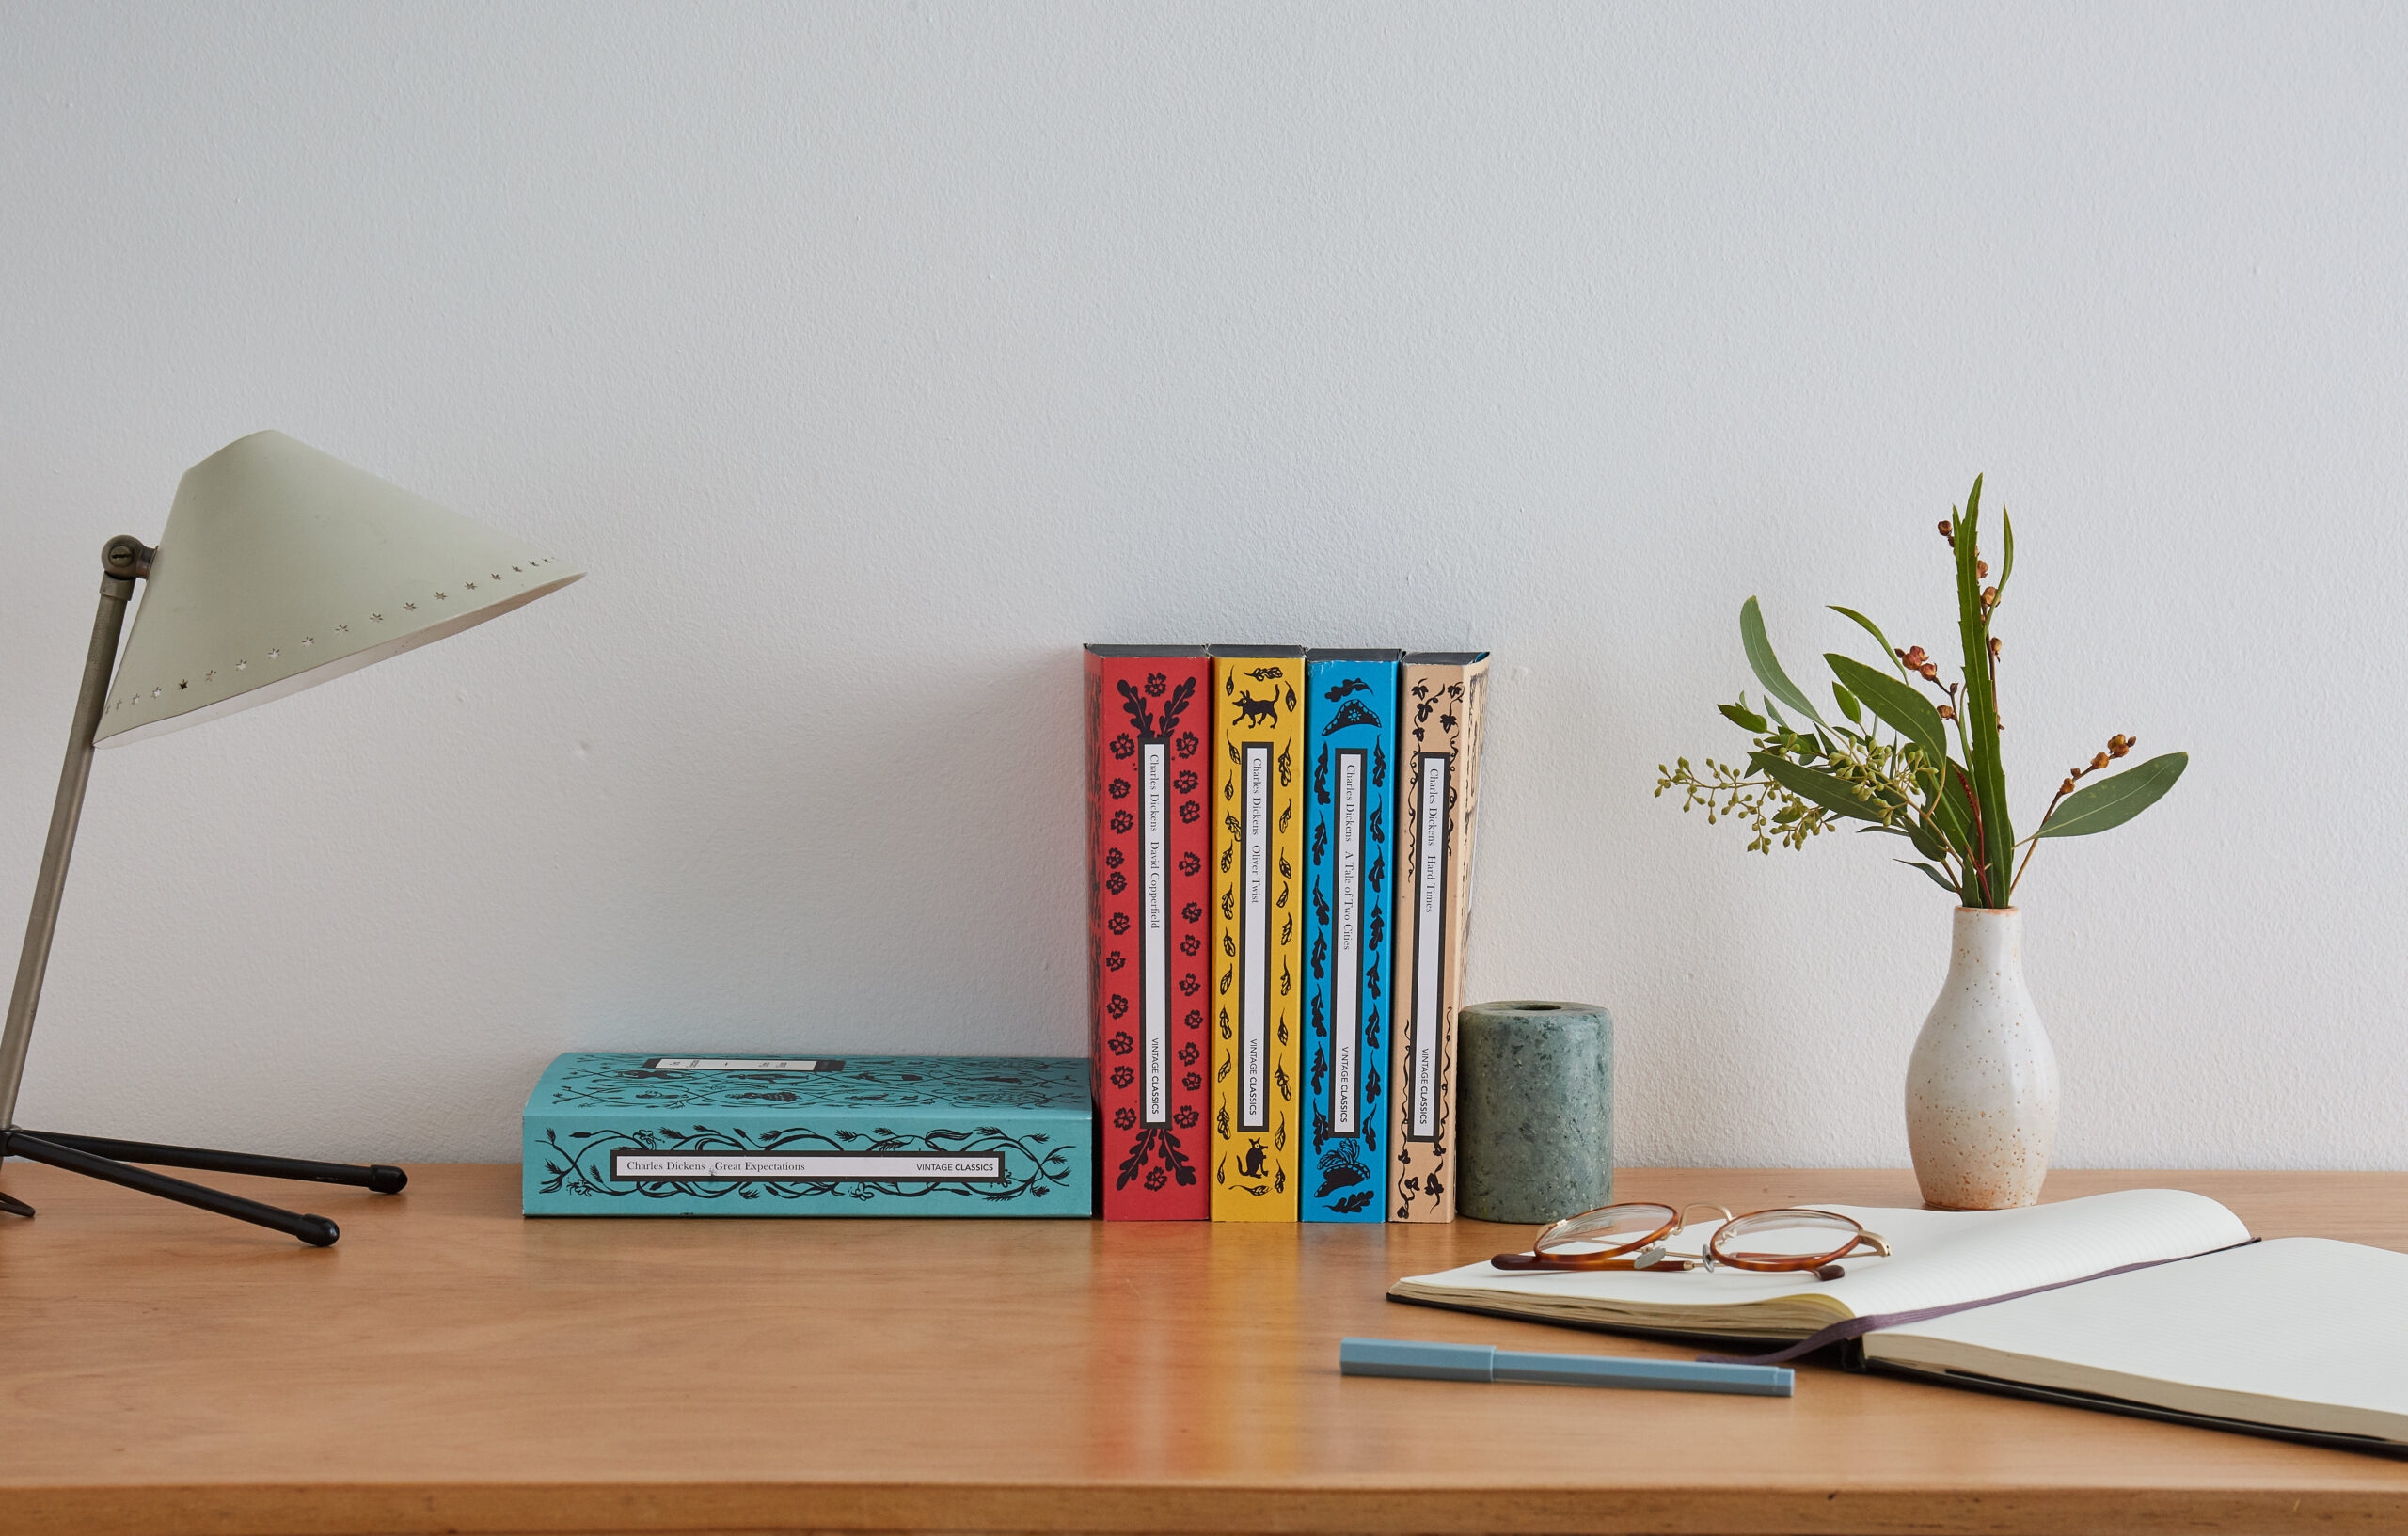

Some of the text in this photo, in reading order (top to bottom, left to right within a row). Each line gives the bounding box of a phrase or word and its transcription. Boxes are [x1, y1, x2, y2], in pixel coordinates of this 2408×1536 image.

[1149, 753, 1161, 929] Charles Dickens David Copperfield
[1251, 757, 1262, 904] Charles Dickens Oliver Twist
[1343, 764, 1356, 951] Charles Dickens A Tale of Two Cities
[1425, 768, 1439, 913] Charles Dickens Hard Times
[1151, 1037, 1160, 1115] VINTAGE CLASSICS
[1248, 1038, 1258, 1116] VINTAGE CLASSICS
[1339, 1046, 1350, 1123] VINTAGE CLASSICS
[1419, 1048, 1430, 1125] VINTAGE CLASSICS
[626, 1161, 805, 1173] Charles Dickens Great Expectations
[916, 1164, 994, 1172] VINTAGE CLASSICS
